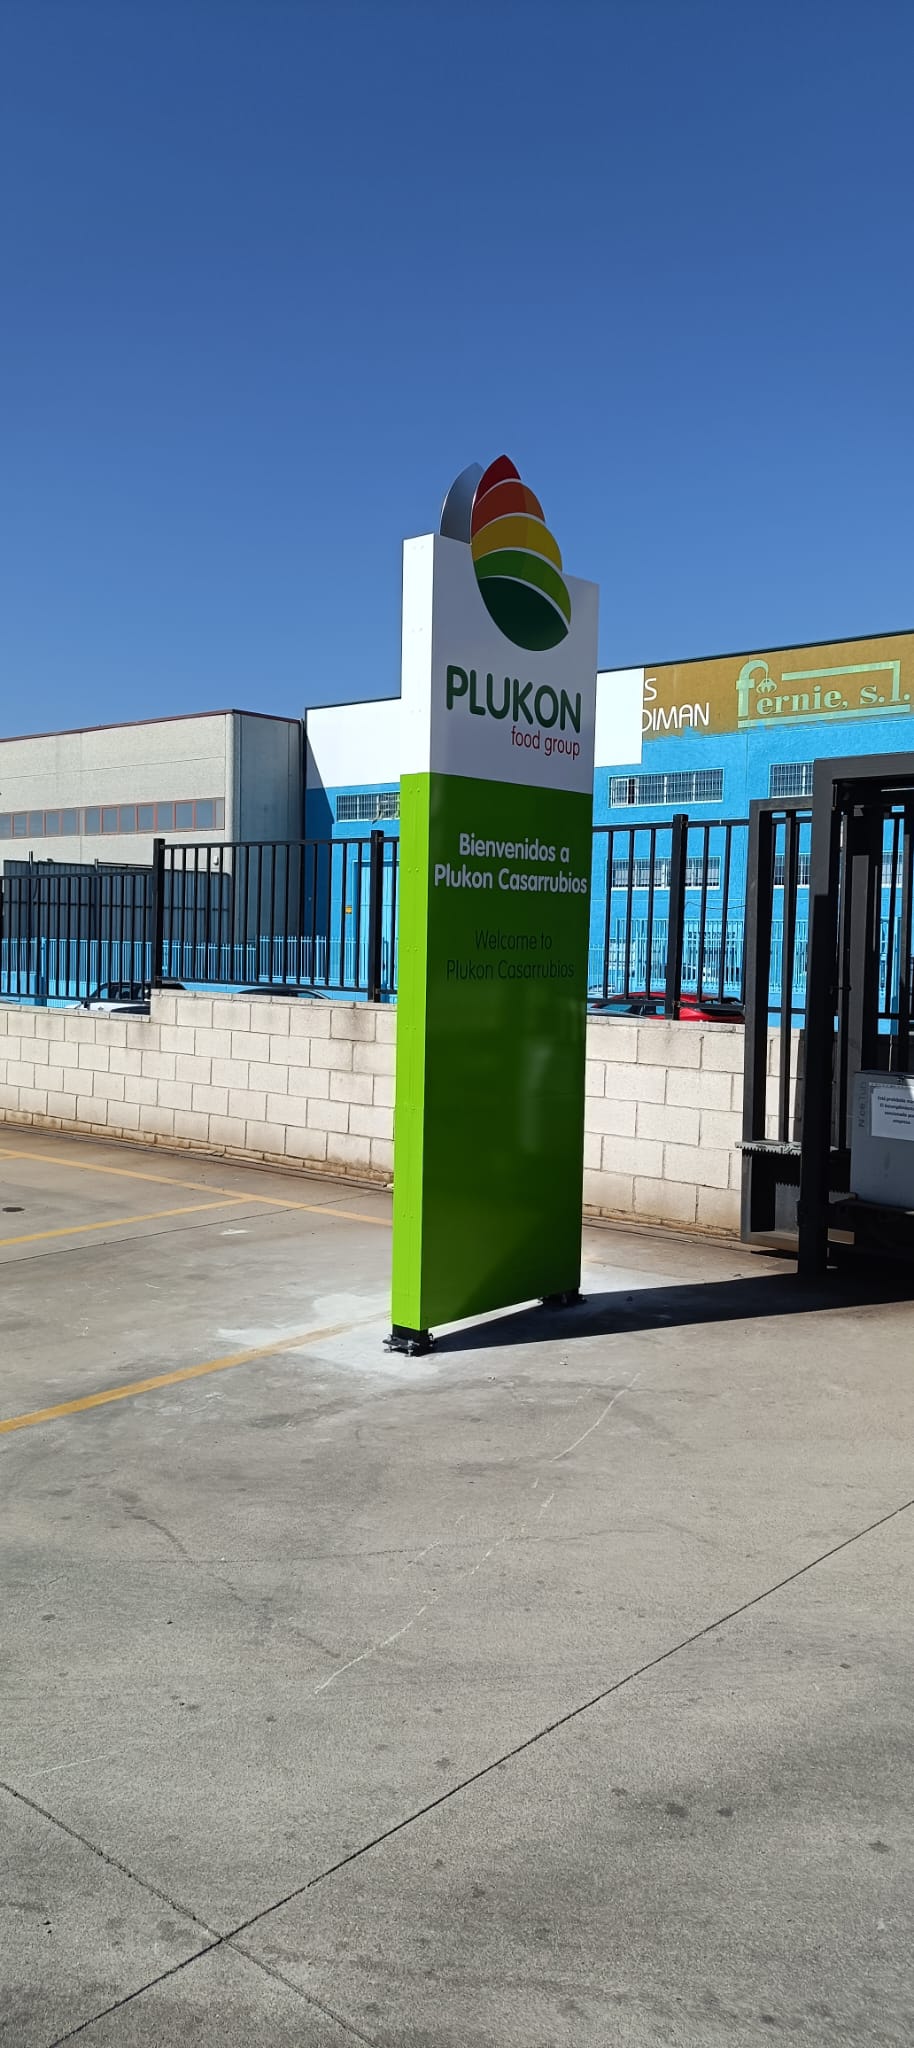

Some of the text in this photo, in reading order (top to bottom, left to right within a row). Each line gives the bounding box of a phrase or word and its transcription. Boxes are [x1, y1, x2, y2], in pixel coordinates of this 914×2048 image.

[446, 664, 582, 734] PLUKON
[736, 659, 849, 717] fernie,
[511, 725, 581, 761] food group
[458, 832, 570, 863] Bienvenidos a
[434, 863, 588, 894] Plukon Casarrubios
[475, 929, 553, 950] Welcome to
[446, 959, 575, 981] Plukon Casarrubios
